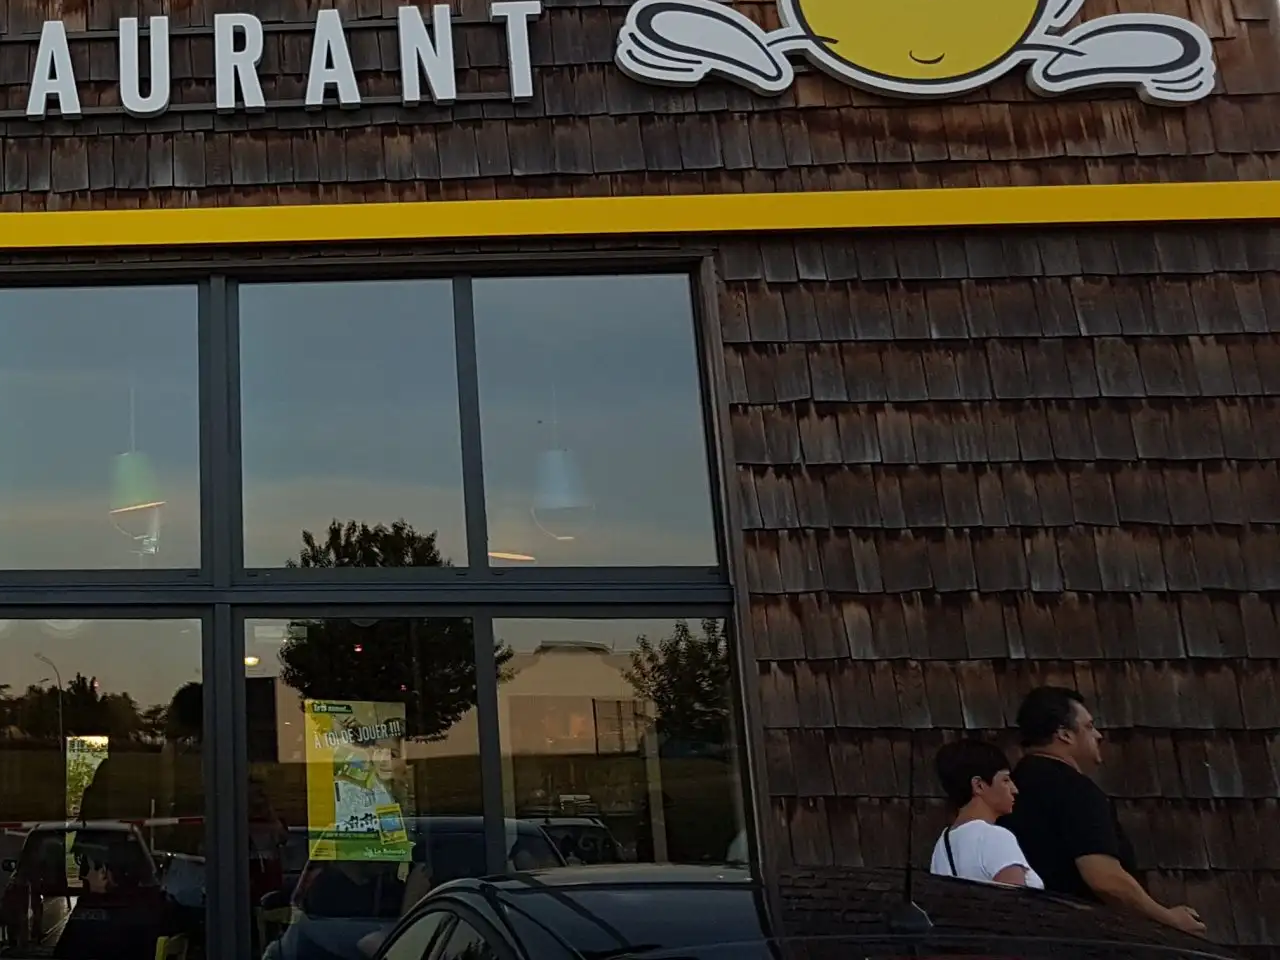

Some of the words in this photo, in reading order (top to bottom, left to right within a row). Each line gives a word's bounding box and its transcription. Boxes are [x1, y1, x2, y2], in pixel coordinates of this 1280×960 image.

[324, 730, 339, 746] TOI
[341, 728, 355, 745] DE
[357, 724, 389, 742] JOUER
[389, 720, 402, 737] !!!
